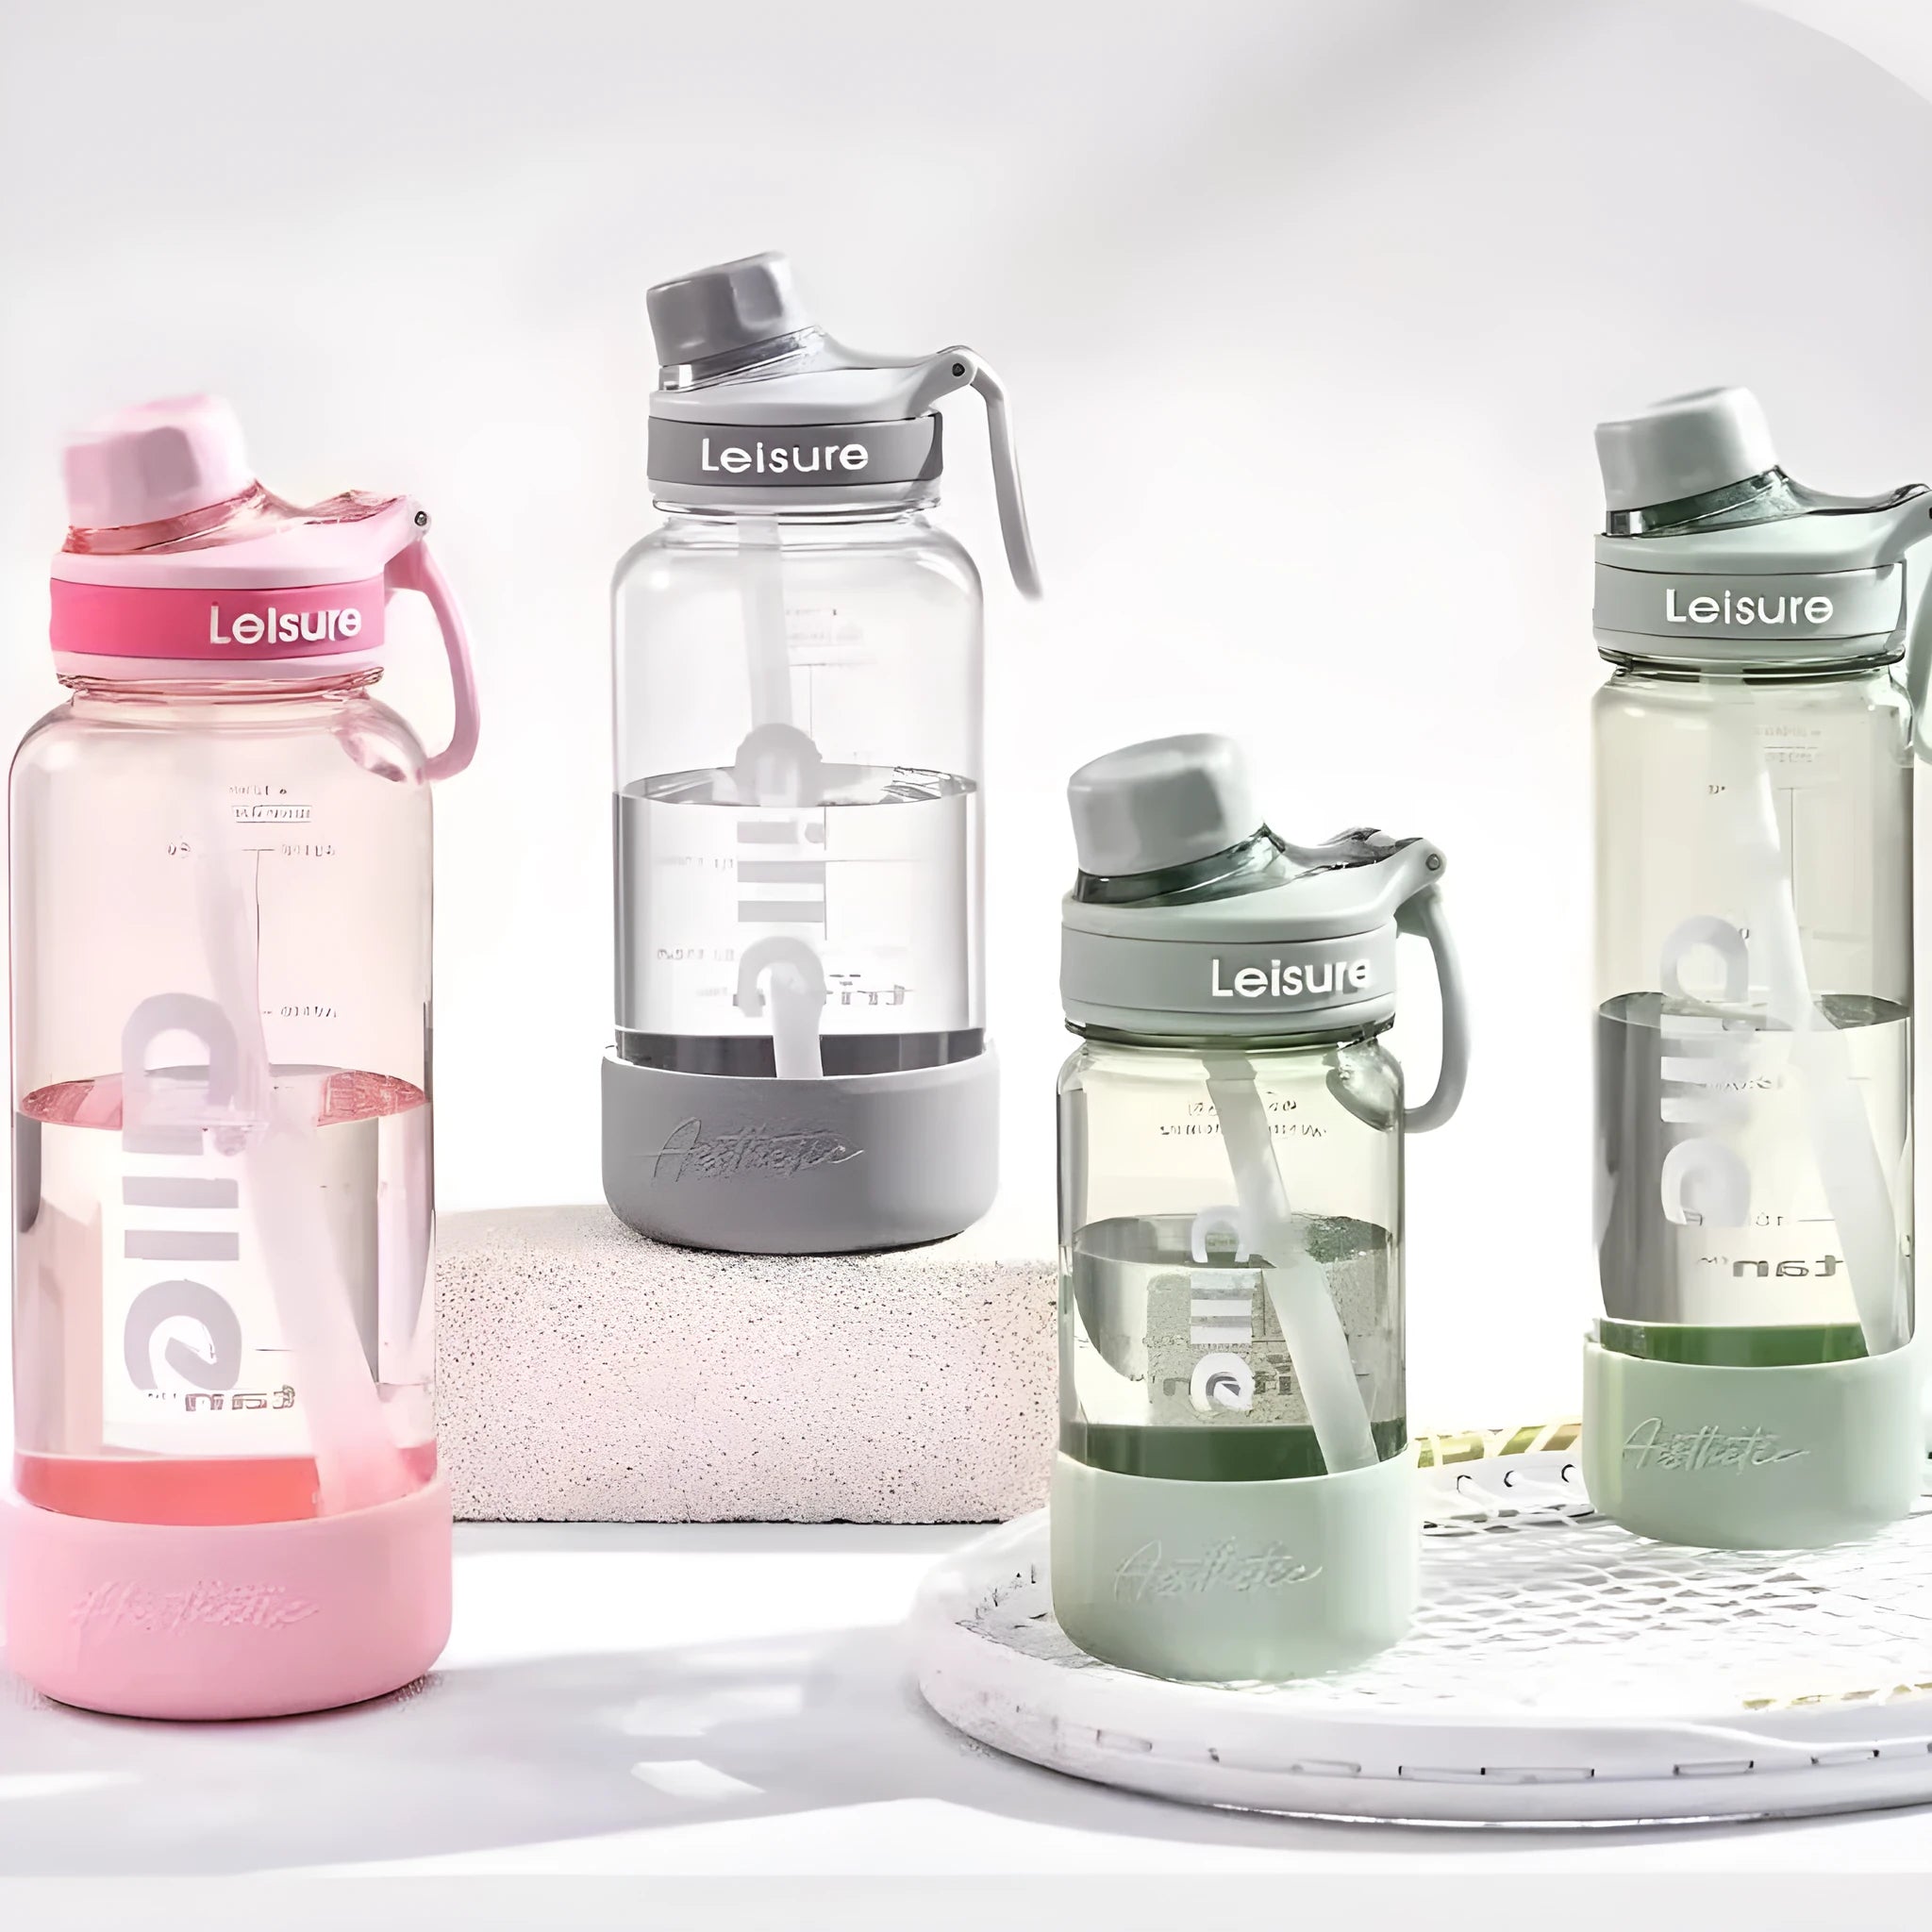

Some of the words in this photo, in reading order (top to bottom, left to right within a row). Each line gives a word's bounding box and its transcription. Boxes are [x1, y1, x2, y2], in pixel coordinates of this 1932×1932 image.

[701, 437, 870, 475] Leisure
[1665, 588, 1835, 625] Leisure
[1210, 958, 1374, 999] Leisure
